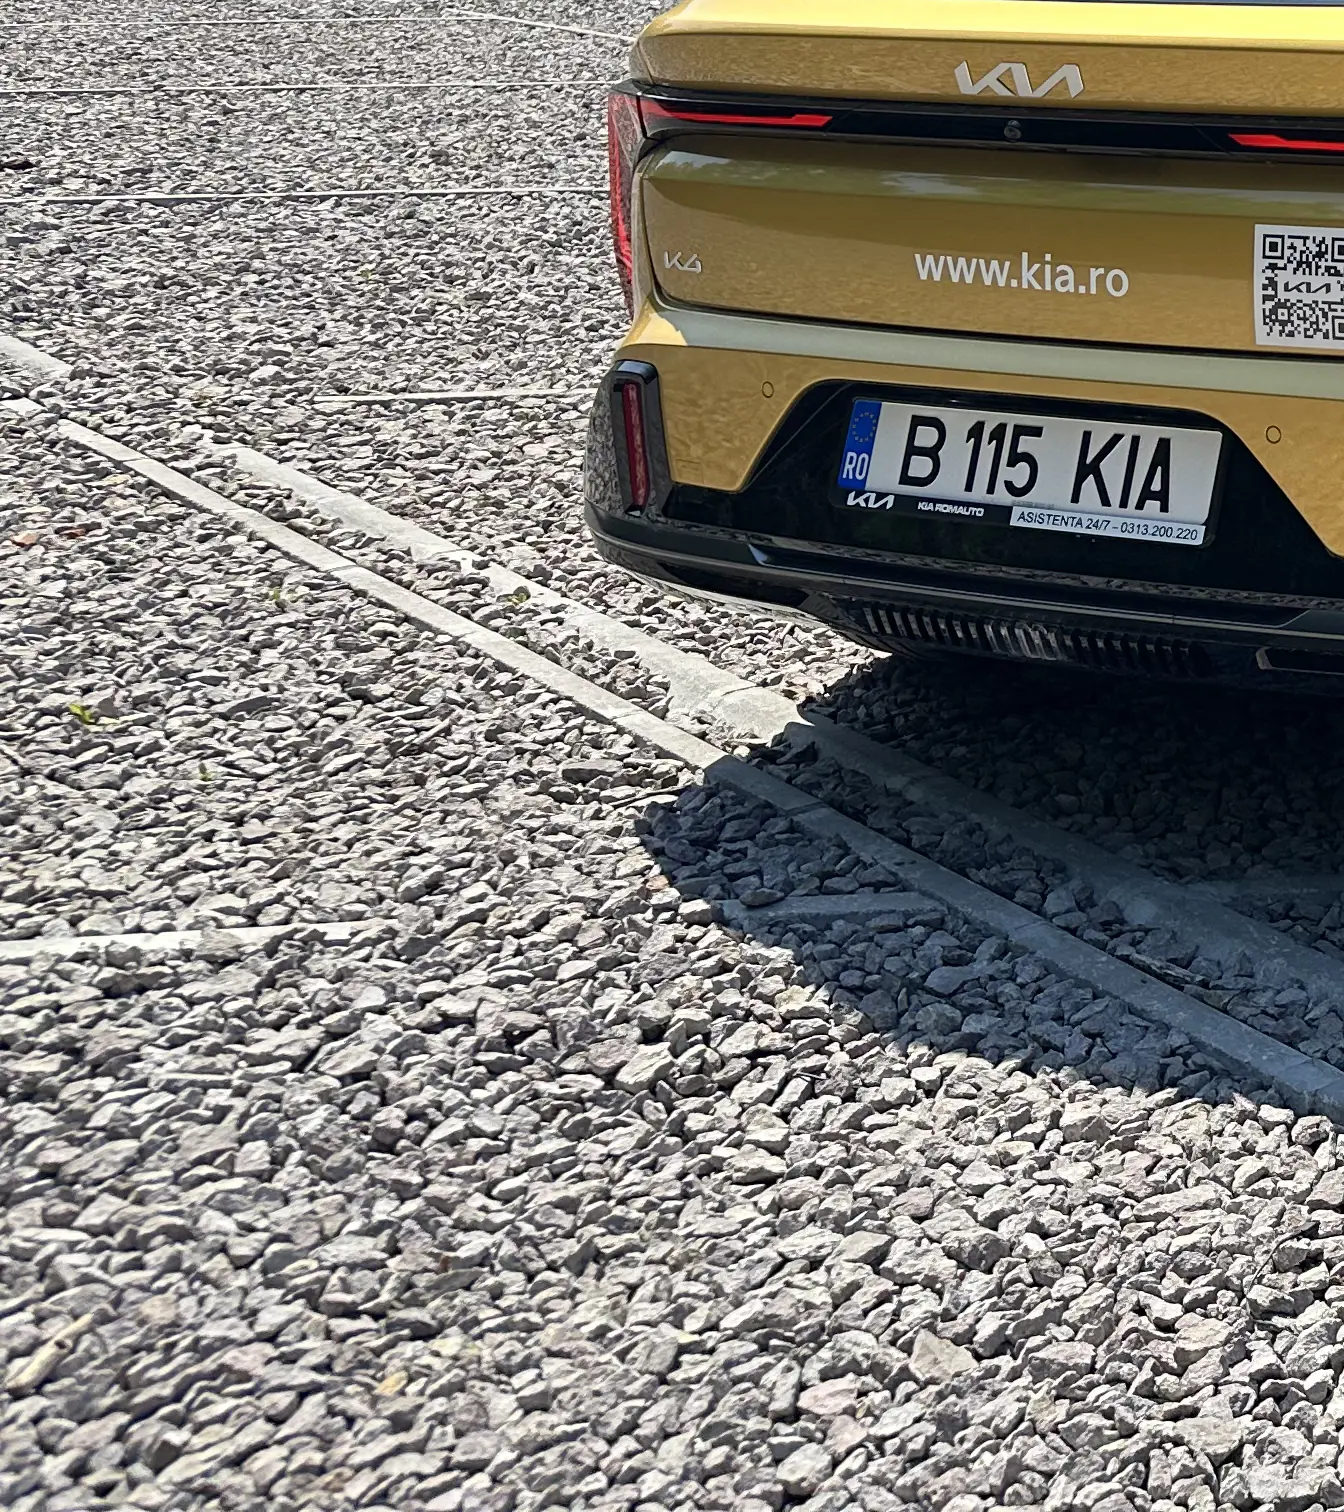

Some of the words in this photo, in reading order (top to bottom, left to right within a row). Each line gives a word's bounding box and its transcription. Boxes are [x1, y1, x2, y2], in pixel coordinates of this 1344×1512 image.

[954, 60, 1085, 98] KIA
[663, 251, 702, 273] K4
[914, 252, 1129, 297] www.kia.ro
[842, 451, 869, 481] RO
[898, 414, 947, 488] B
[963, 420, 1044, 498] 115
[1069, 430, 1172, 514] KIA
[846, 490, 896, 510] KIA
[917, 501, 935, 512] KIA
[935, 504, 985, 517] ROMAUTO
[1017, 510, 1083, 529] ASISTENTA
[1085, 518, 1111, 531] 24/7
[1120, 522, 1198, 541] 0313.200.220
